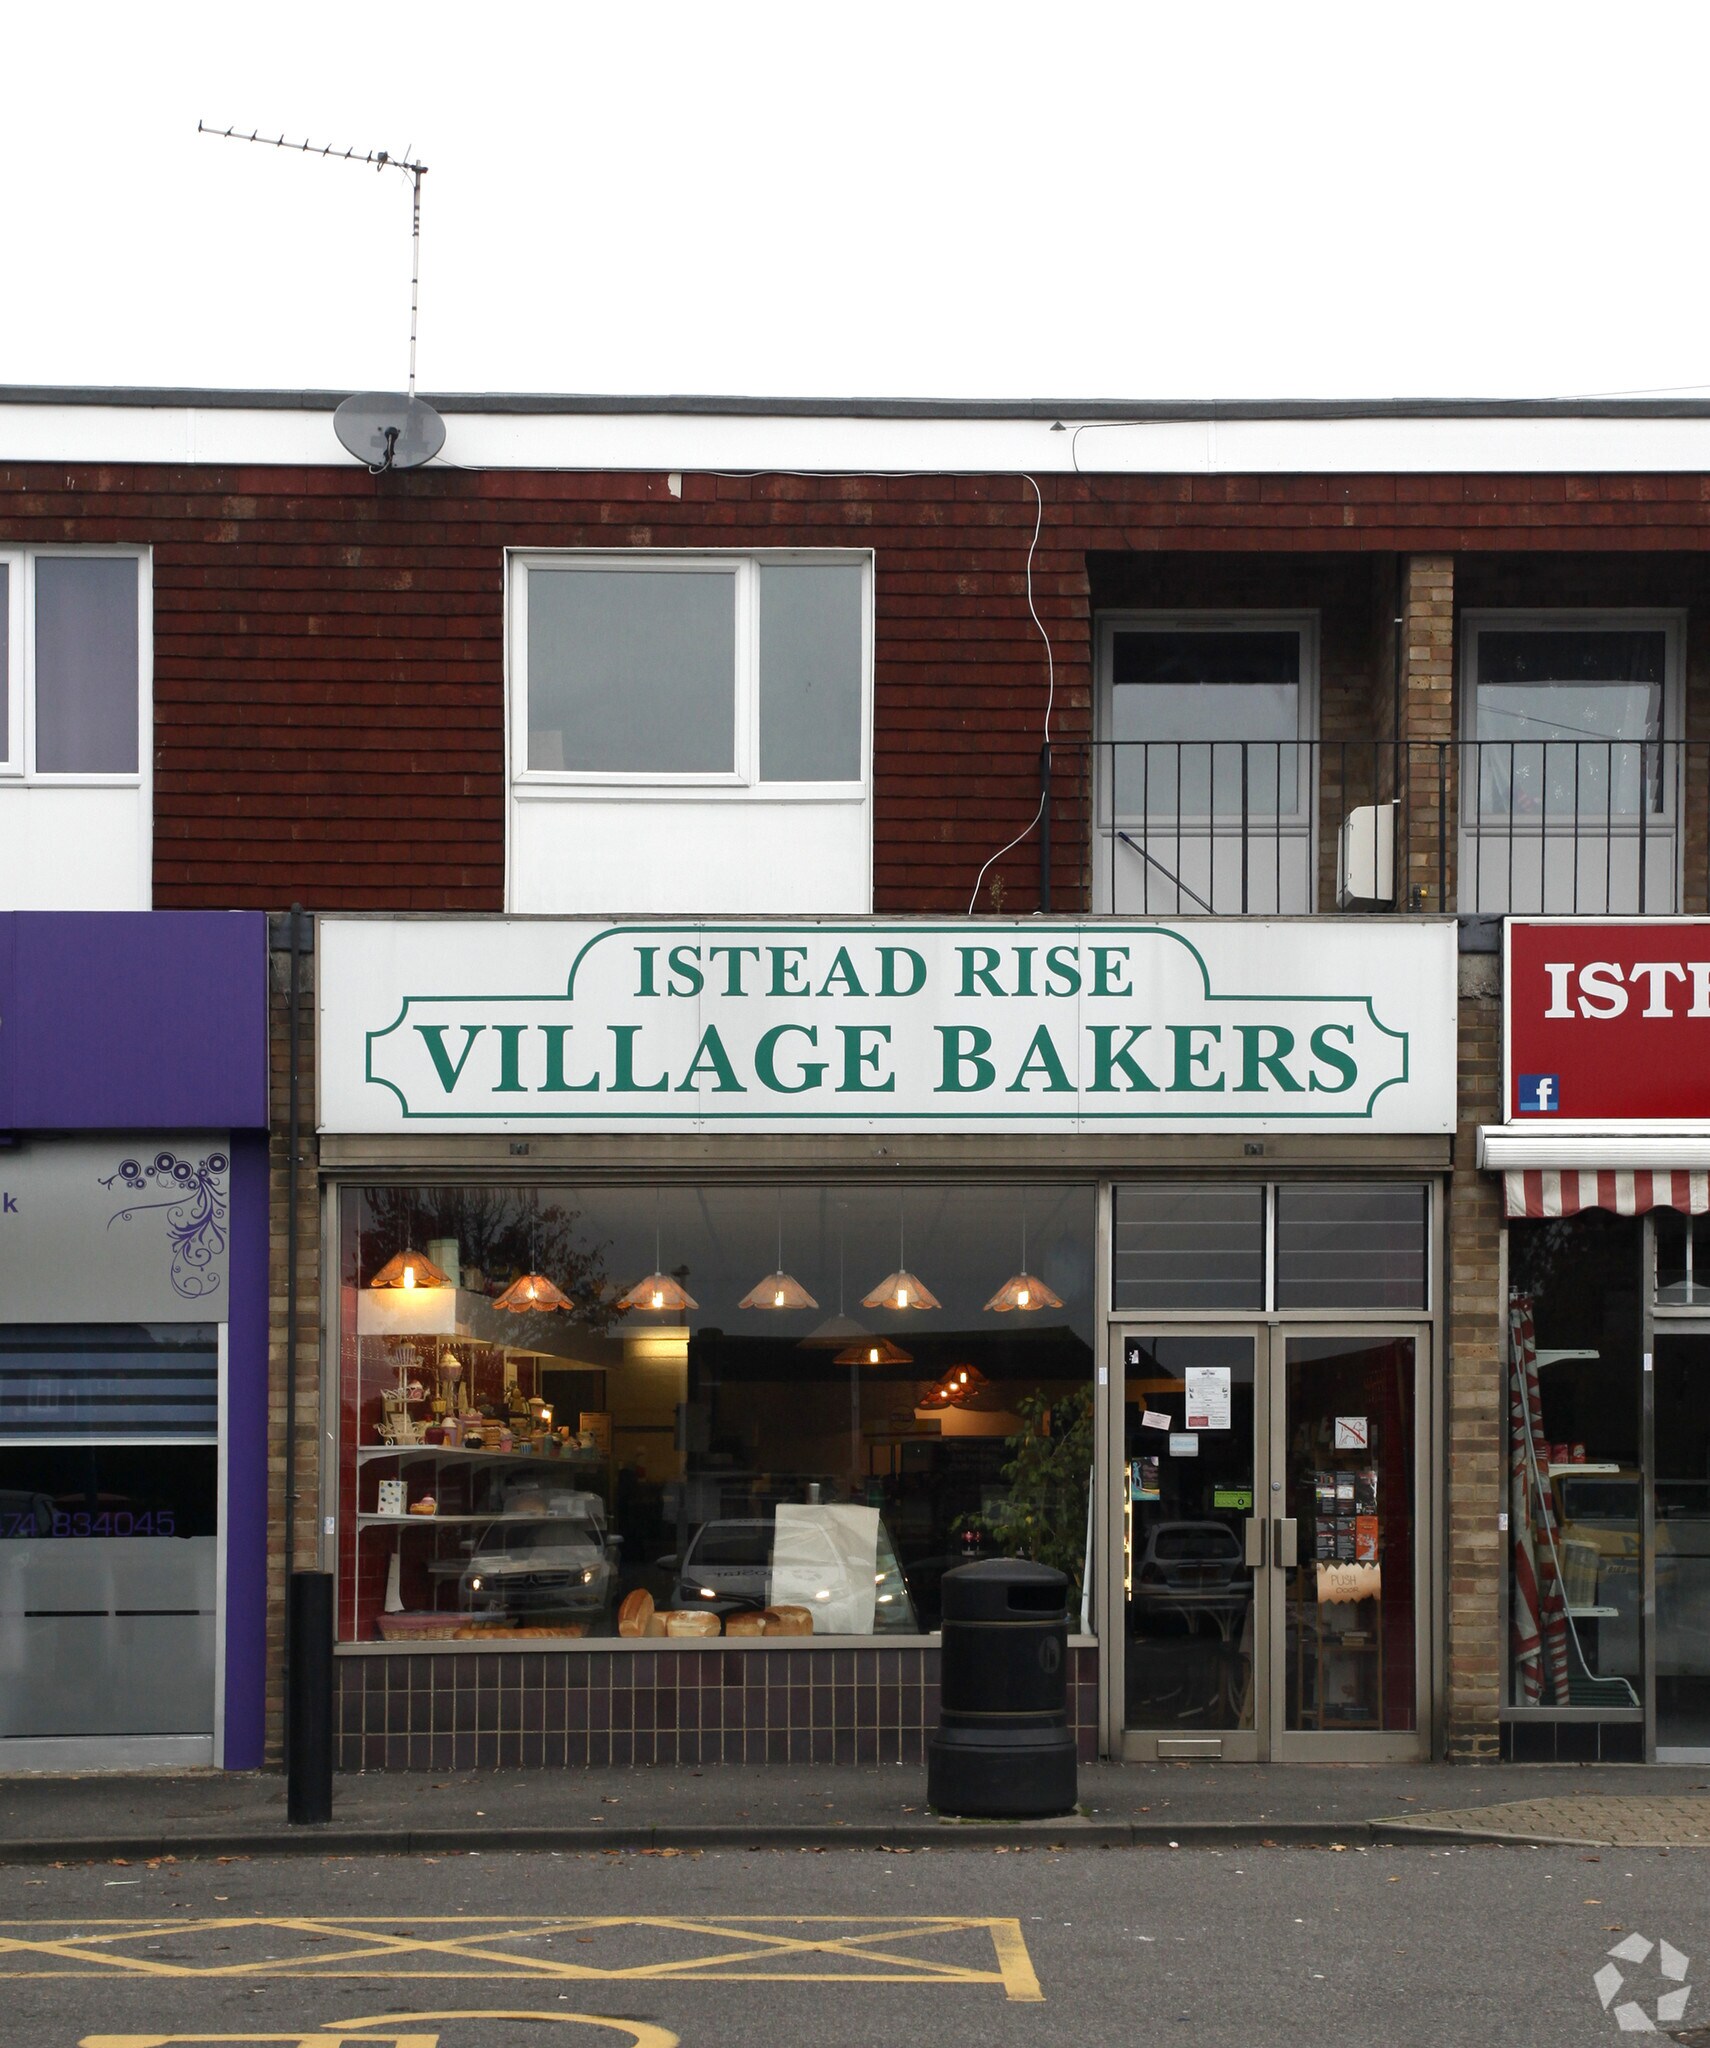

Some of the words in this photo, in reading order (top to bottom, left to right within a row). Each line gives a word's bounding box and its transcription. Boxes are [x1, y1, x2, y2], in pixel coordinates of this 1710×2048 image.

[636, 946, 928, 998] ISTEAD
[957, 946, 1135, 998] RISE
[414, 1023, 896, 1093] VILLAGE
[934, 1023, 1360, 1093] BAKERS
[0, 1512, 37, 1537] 74
[52, 1510, 176, 1537] 834045
[1331, 1574, 1357, 1586] PUSH
